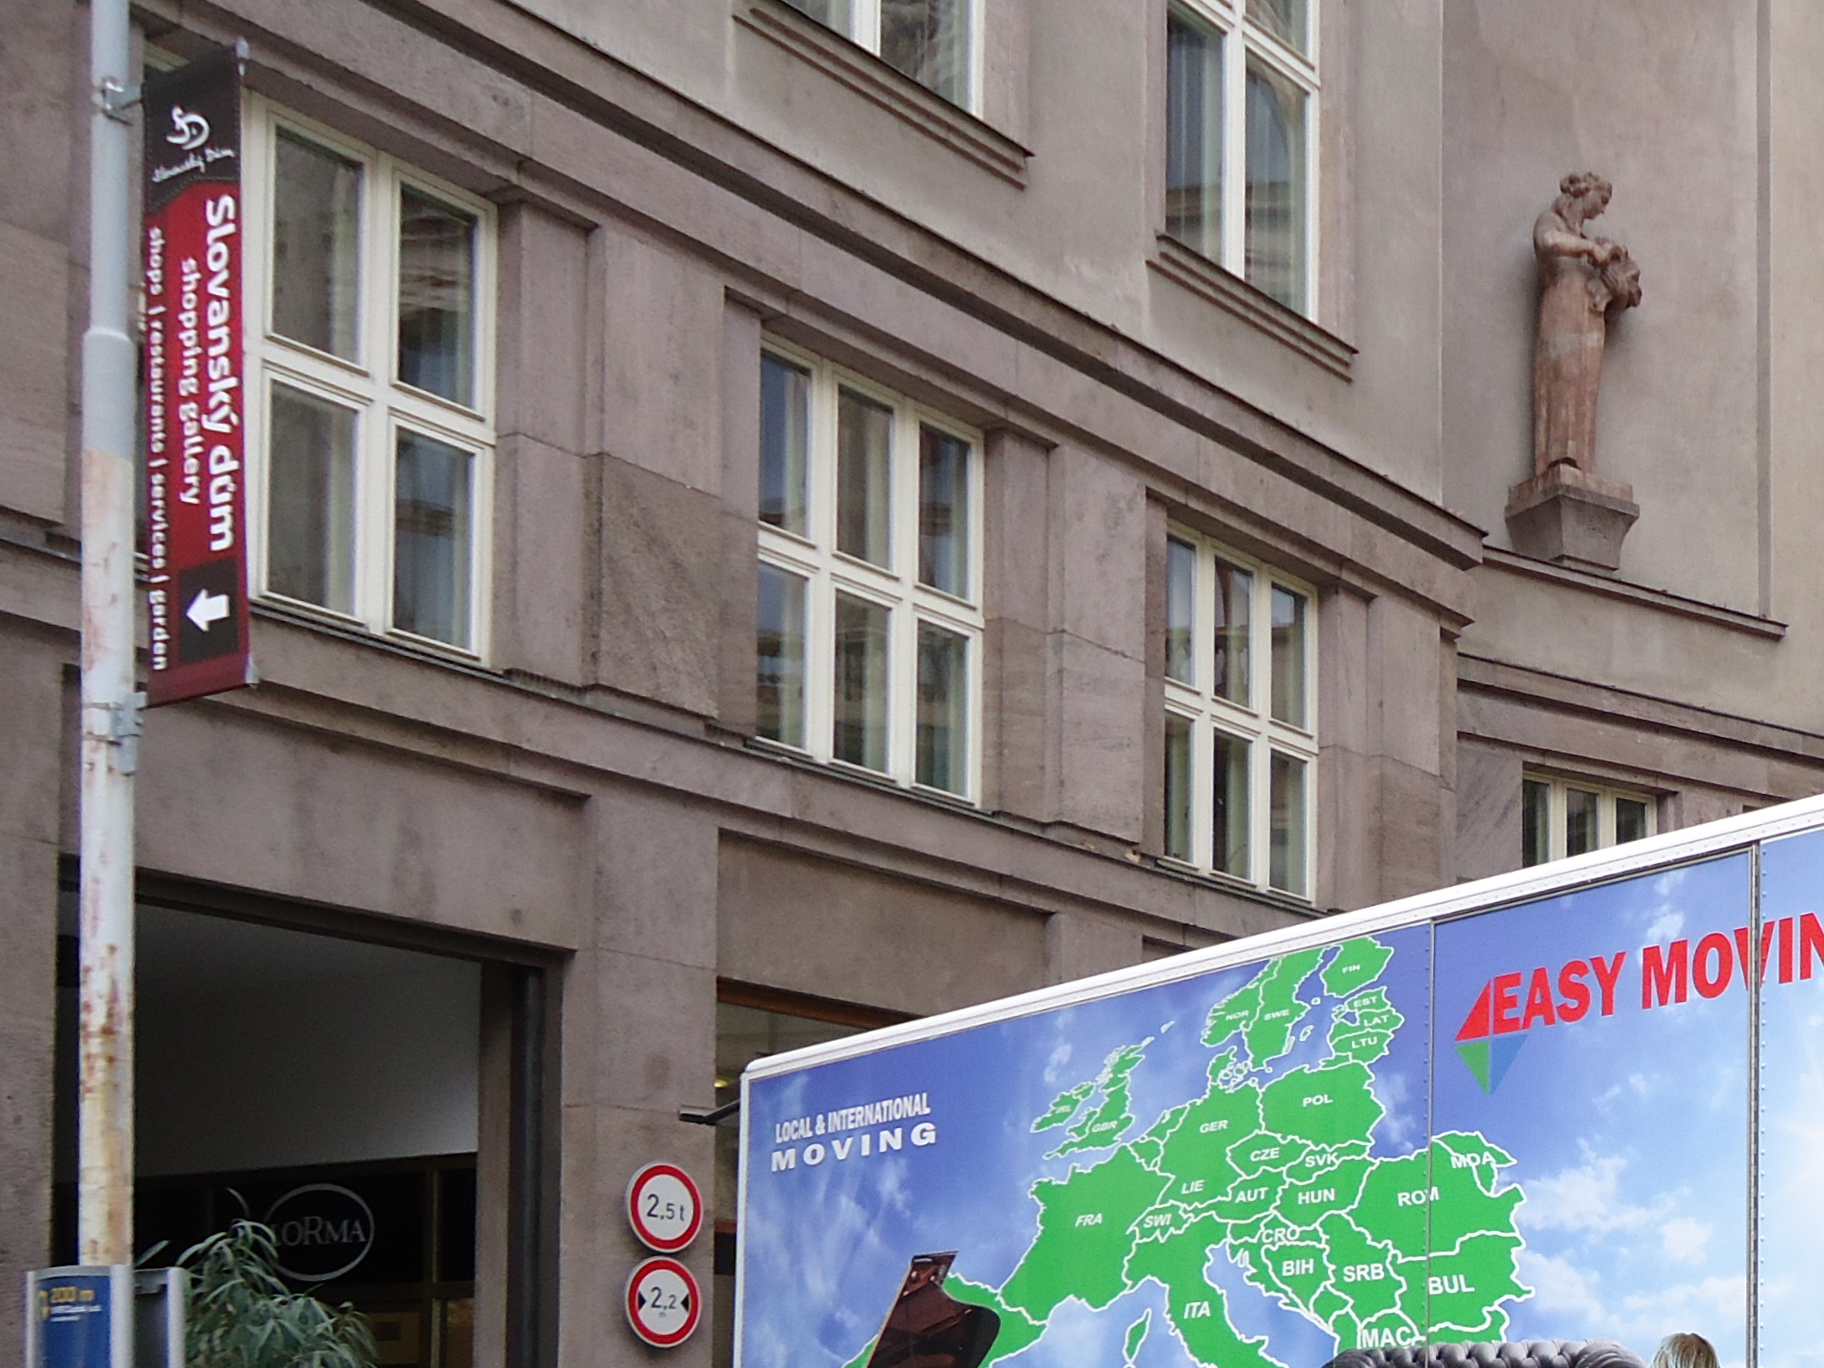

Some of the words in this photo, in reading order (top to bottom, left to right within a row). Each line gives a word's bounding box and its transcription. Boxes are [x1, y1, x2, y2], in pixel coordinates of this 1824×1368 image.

[146, 226, 166, 296] shops
[202, 194, 240, 434] Slovanský
[178, 257, 203, 397] shopping
[149, 320, 168, 453] restaurants
[179, 402, 205, 504] gallery
[209, 445, 240, 551] dům
[151, 472, 170, 570] services
[149, 589, 171, 670] garden
[1342, 963, 1361, 974] FIN
[1493, 951, 1627, 1035] EASY
[1353, 996, 1378, 1008] EST
[1226, 1009, 1249, 1021] NOR
[1264, 1008, 1290, 1021] SWE
[1363, 1014, 1390, 1027] LAT
[1351, 1036, 1378, 1049] LTU
[1302, 1094, 1333, 1107] POL
[775, 1116, 814, 1144] LOCAL
[815, 1113, 826, 1135] &
[828, 1092, 931, 1133] INTERNATIONAL
[1200, 1119, 1229, 1133] GER
[1092, 1121, 1118, 1133] GBR
[771, 1122, 937, 1172] MOVING
[1250, 1147, 1280, 1161] CZE
[1305, 1152, 1339, 1167] SVK
[1181, 1179, 1205, 1194] LIE
[1235, 1187, 1269, 1203] AUT
[1298, 1188, 1335, 1205] HUN
[1397, 1187, 1439, 1206] ROM
[1075, 1213, 1103, 1227] FRA
[1143, 1213, 1172, 1228] SWI
[1261, 1228, 1300, 1243] CRO
[1282, 1258, 1314, 1276] BIH
[1343, 1263, 1385, 1282] SRB
[1428, 1274, 1475, 1295] BUL
[1184, 1301, 1211, 1319] ITA
[1362, 1326, 1413, 1347] MAC
